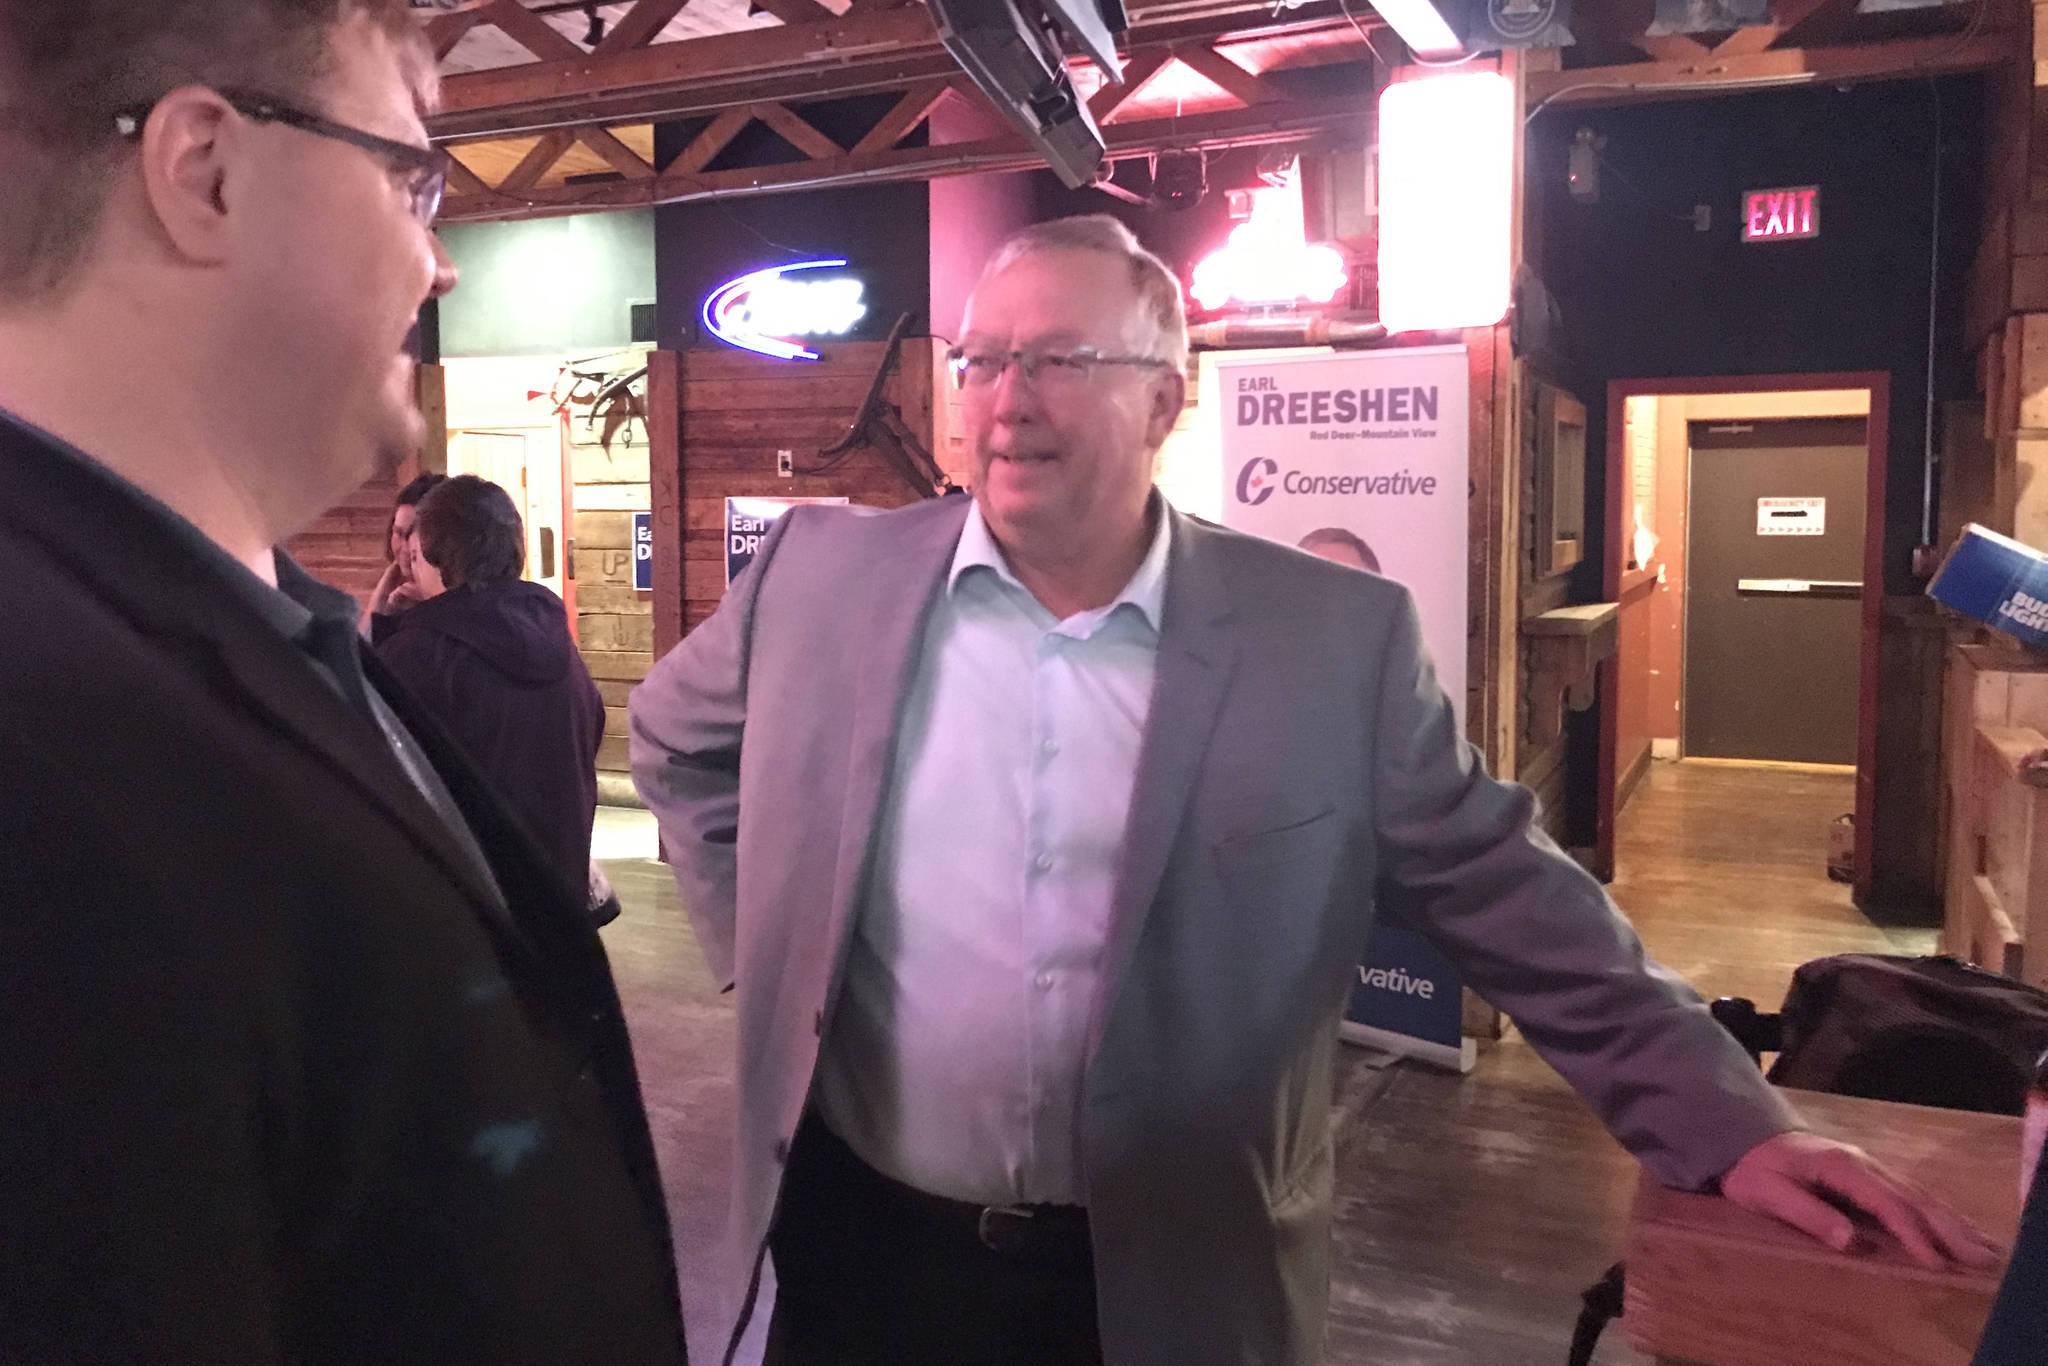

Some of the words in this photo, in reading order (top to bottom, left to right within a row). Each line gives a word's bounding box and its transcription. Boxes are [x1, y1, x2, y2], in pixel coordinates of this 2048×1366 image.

[1748, 190, 1817, 237] EXIT
[1238, 377, 1277, 392] EARL
[1237, 386, 1438, 426] DREESHEN
[1284, 469, 1437, 496] Conservative
[731, 515, 764, 532] Earl
